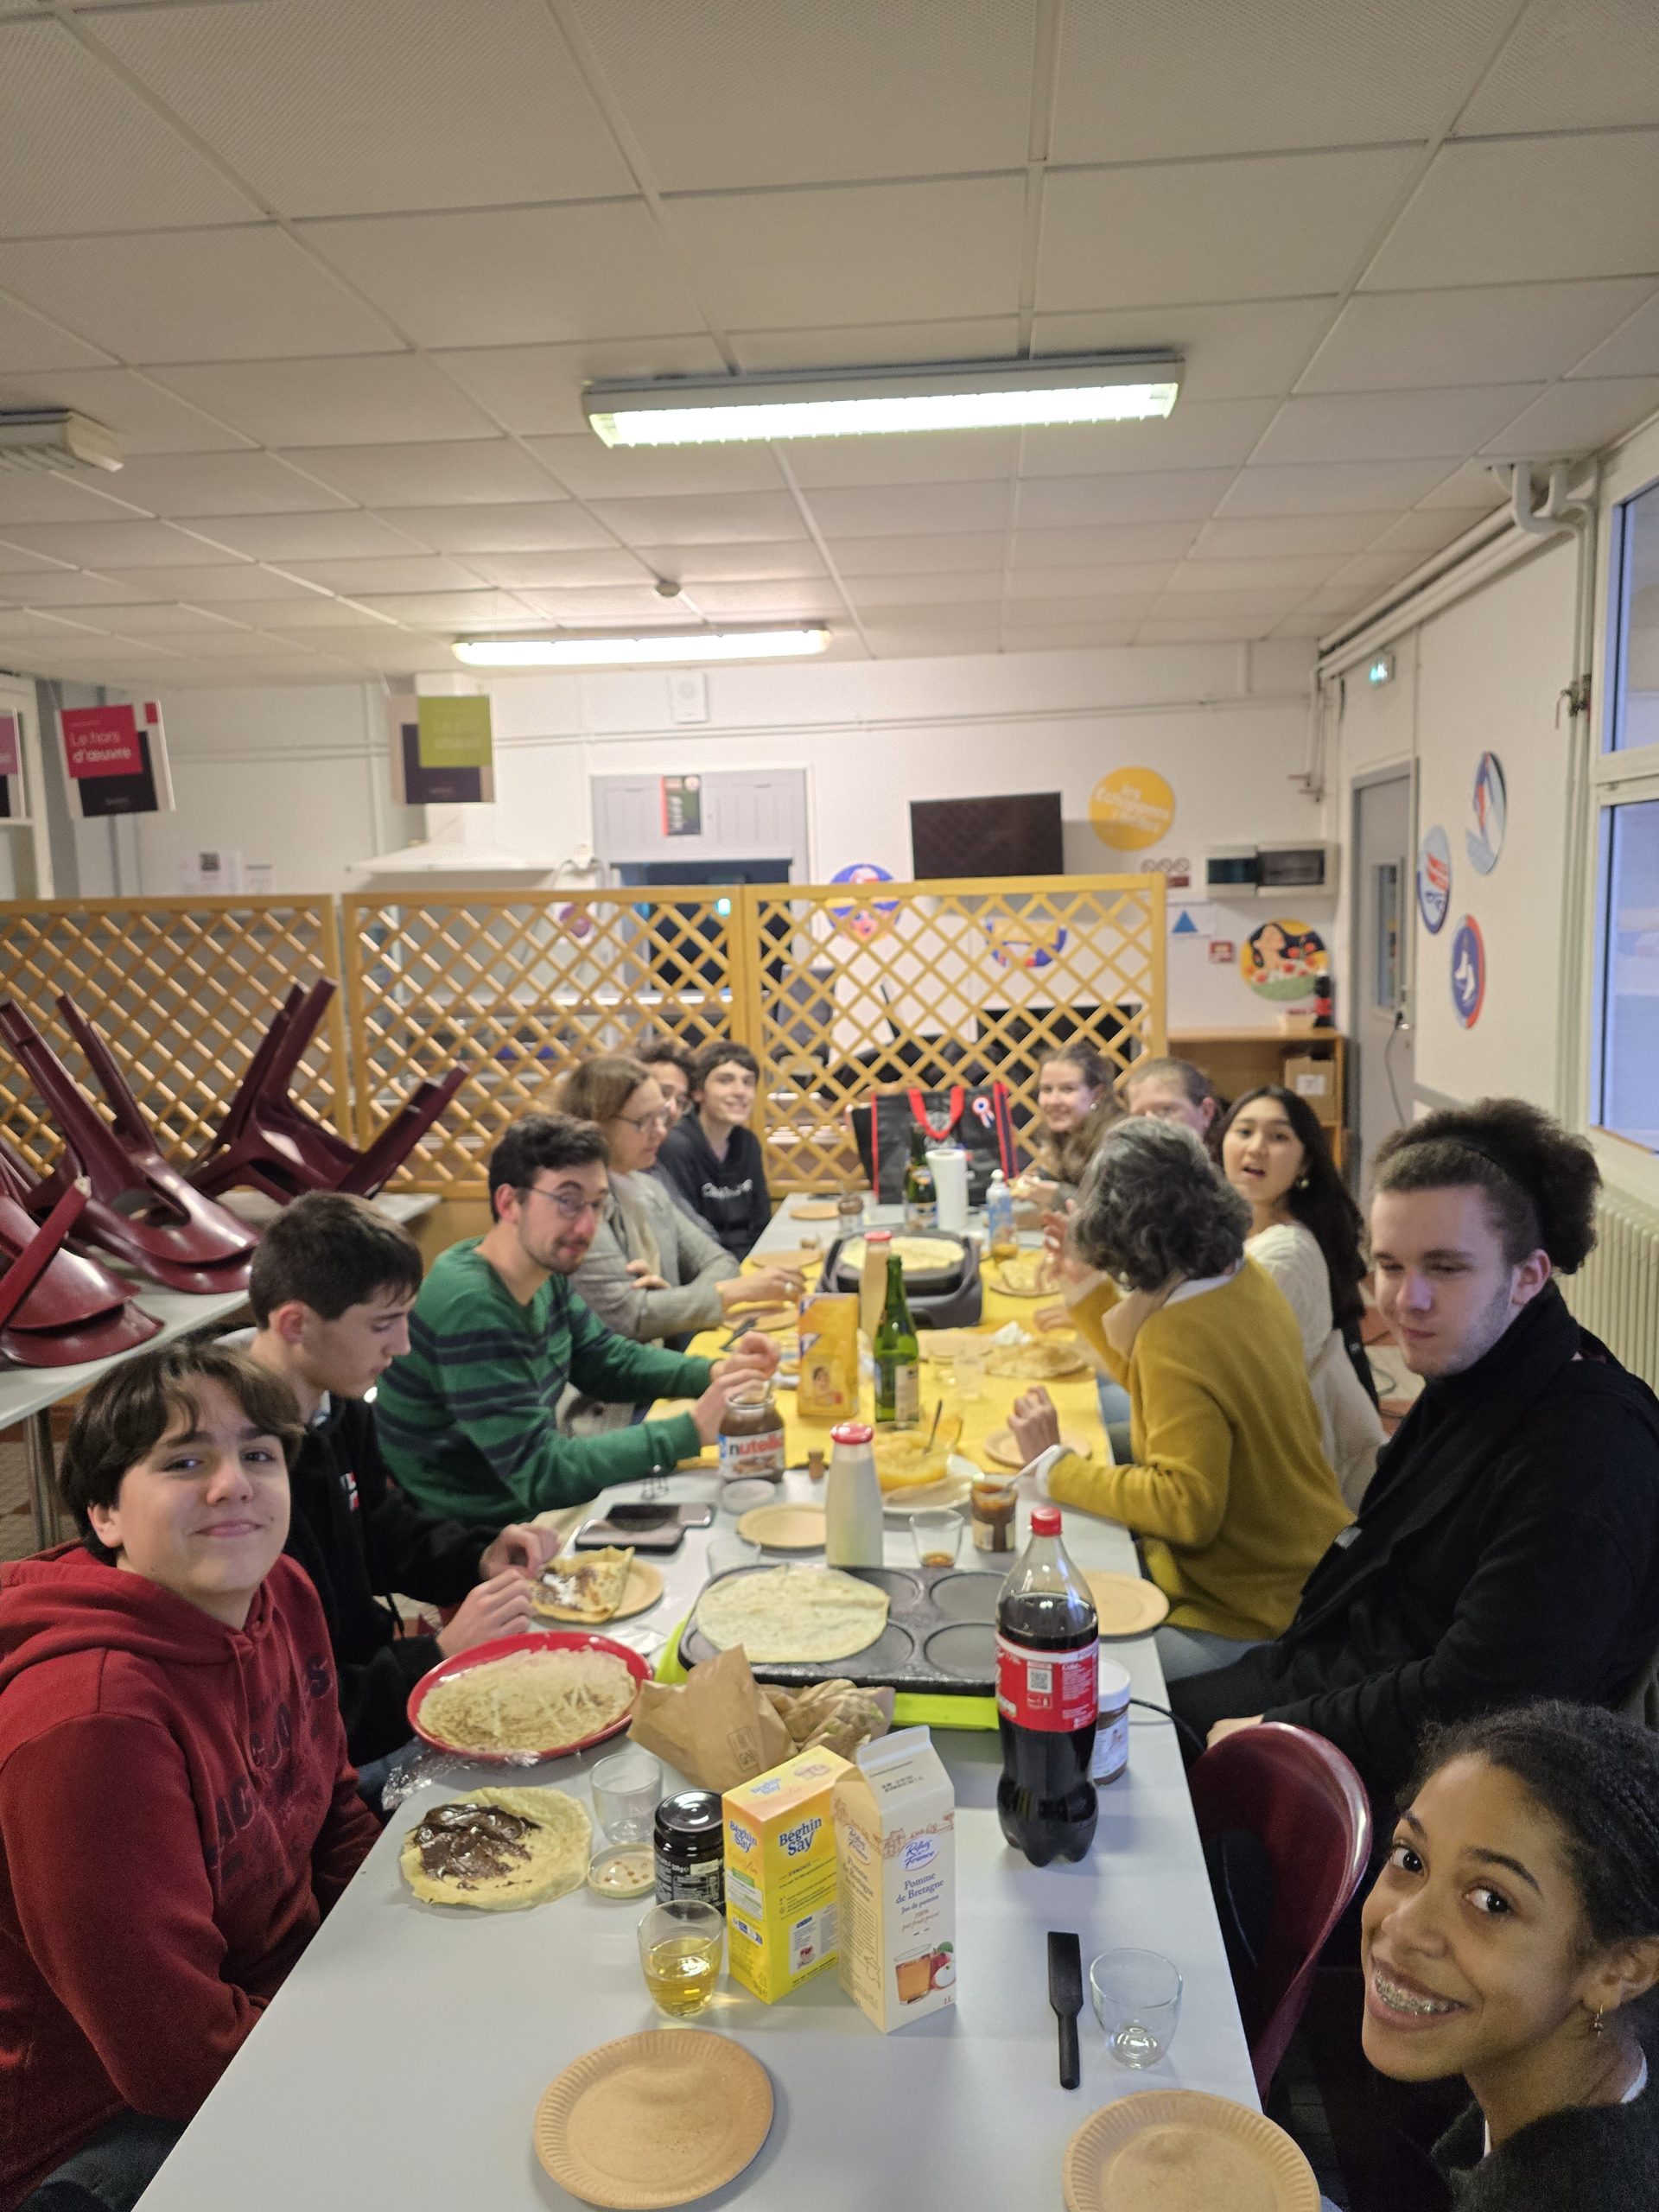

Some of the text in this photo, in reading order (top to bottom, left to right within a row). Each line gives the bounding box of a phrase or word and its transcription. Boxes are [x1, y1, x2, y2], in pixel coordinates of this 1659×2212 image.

[729, 1820, 758, 1847] Béghin
[734, 1832, 752, 1853] Say
[779, 1817, 823, 1847] Béghin
[787, 1831, 815, 1856] Say
[895, 1879, 944, 1904] de Bretagne
[904, 1873, 936, 1891] Pomme
